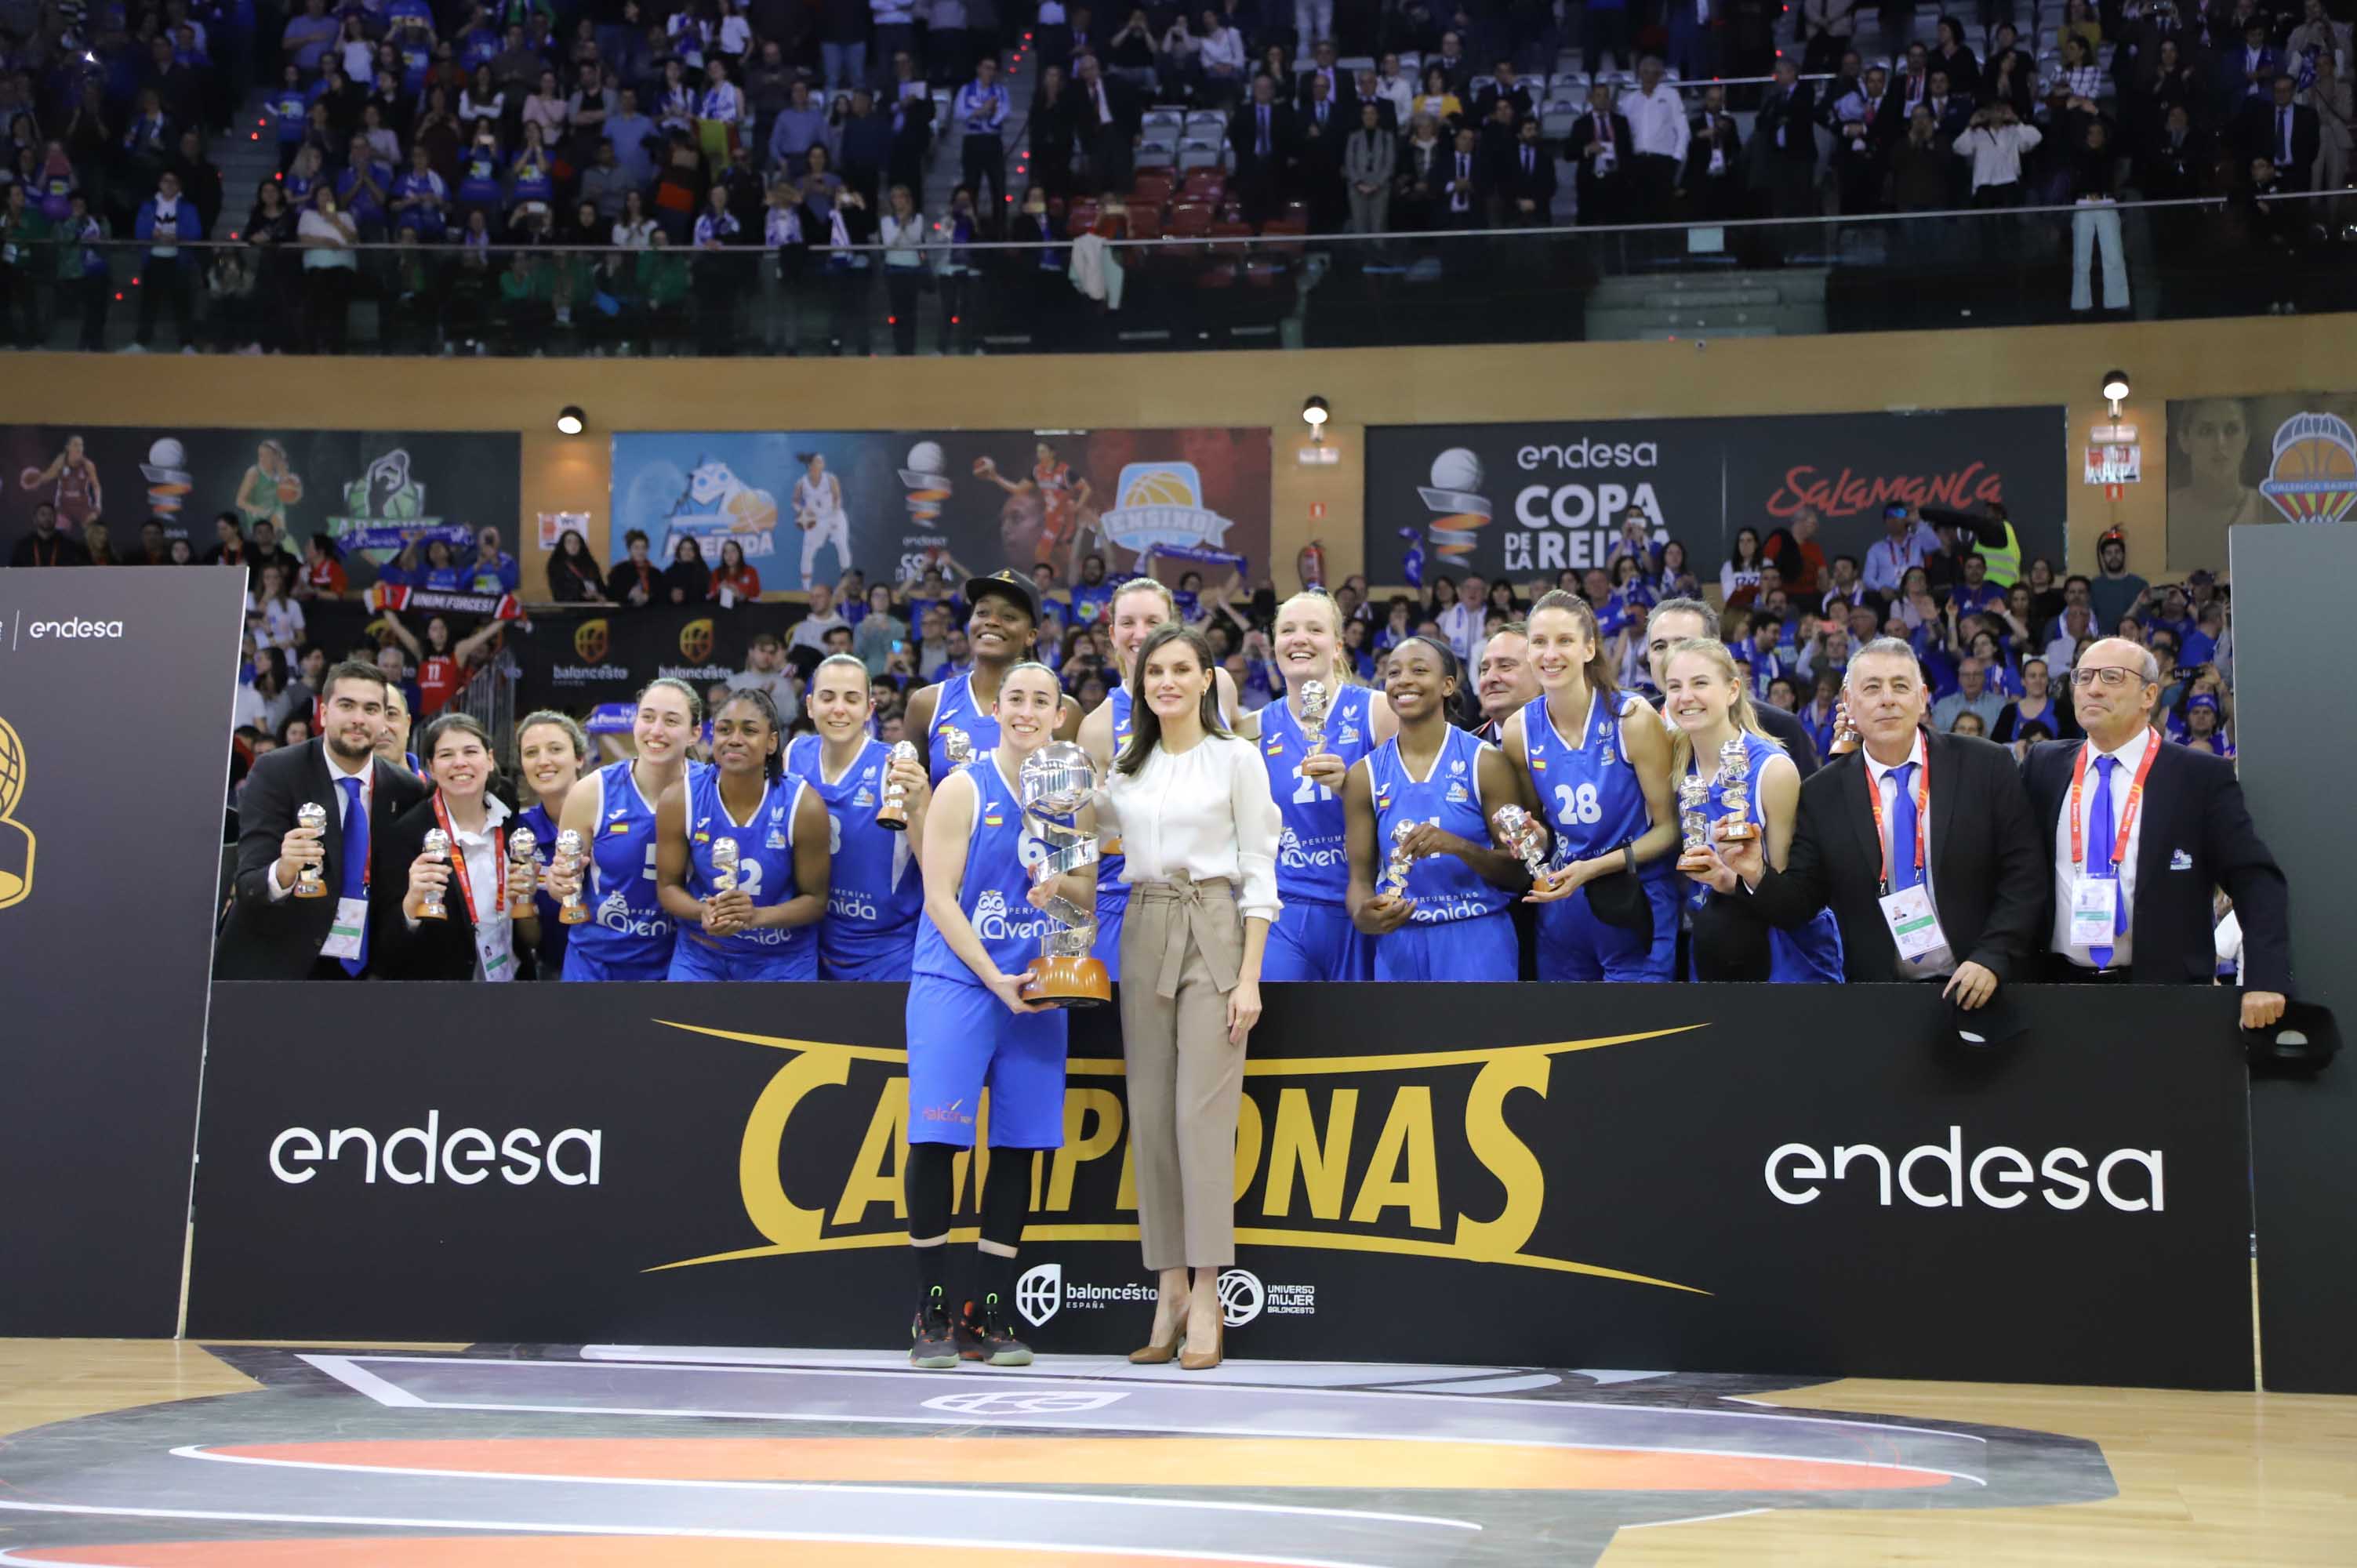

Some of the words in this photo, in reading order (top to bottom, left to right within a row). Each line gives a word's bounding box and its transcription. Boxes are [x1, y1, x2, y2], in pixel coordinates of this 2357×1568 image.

[1517, 437, 1658, 470] endesa
[1515, 482, 1665, 529] COPA
[1111, 511, 1209, 533] ENSINO
[1505, 532, 1532, 551] DE
[1505, 551, 1534, 571] LA
[30, 616, 124, 638] endesa
[553, 665, 628, 681] baloncesto
[1555, 783, 1602, 826] 28
[1017, 828, 1047, 869] 6
[270, 1109, 602, 1185] endesa
[739, 1049, 1552, 1259] CAPNAS
[1764, 1125, 2165, 1212] endesa
[1066, 1283, 1159, 1301] baloncesto
[1267, 1284, 1315, 1294] UNIVERSO
[1267, 1294, 1315, 1306] MUJER
[1066, 1301, 1105, 1309] ESPAÑA
[1267, 1305, 1315, 1315] BALONCESTO
